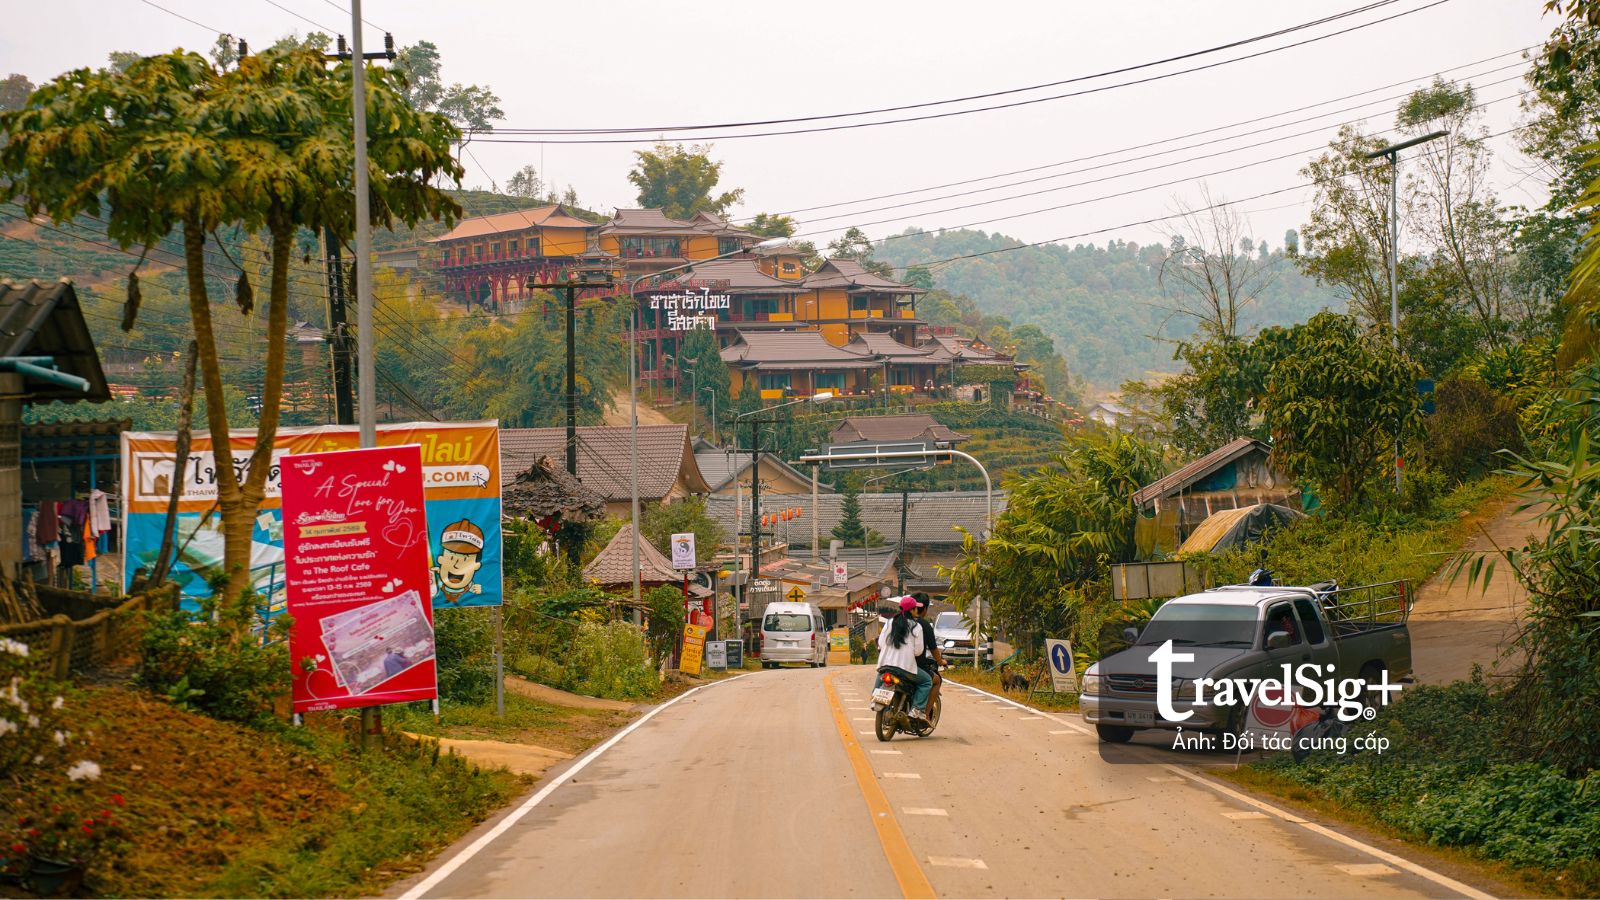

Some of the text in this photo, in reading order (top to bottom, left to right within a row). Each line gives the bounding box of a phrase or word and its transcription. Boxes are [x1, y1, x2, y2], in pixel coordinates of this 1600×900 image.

[314, 472, 391, 498] A Special
[346, 488, 373, 516] Love
[313, 566, 329, 575] The
[330, 564, 349, 573] Roof
[351, 562, 370, 571] Cafe
